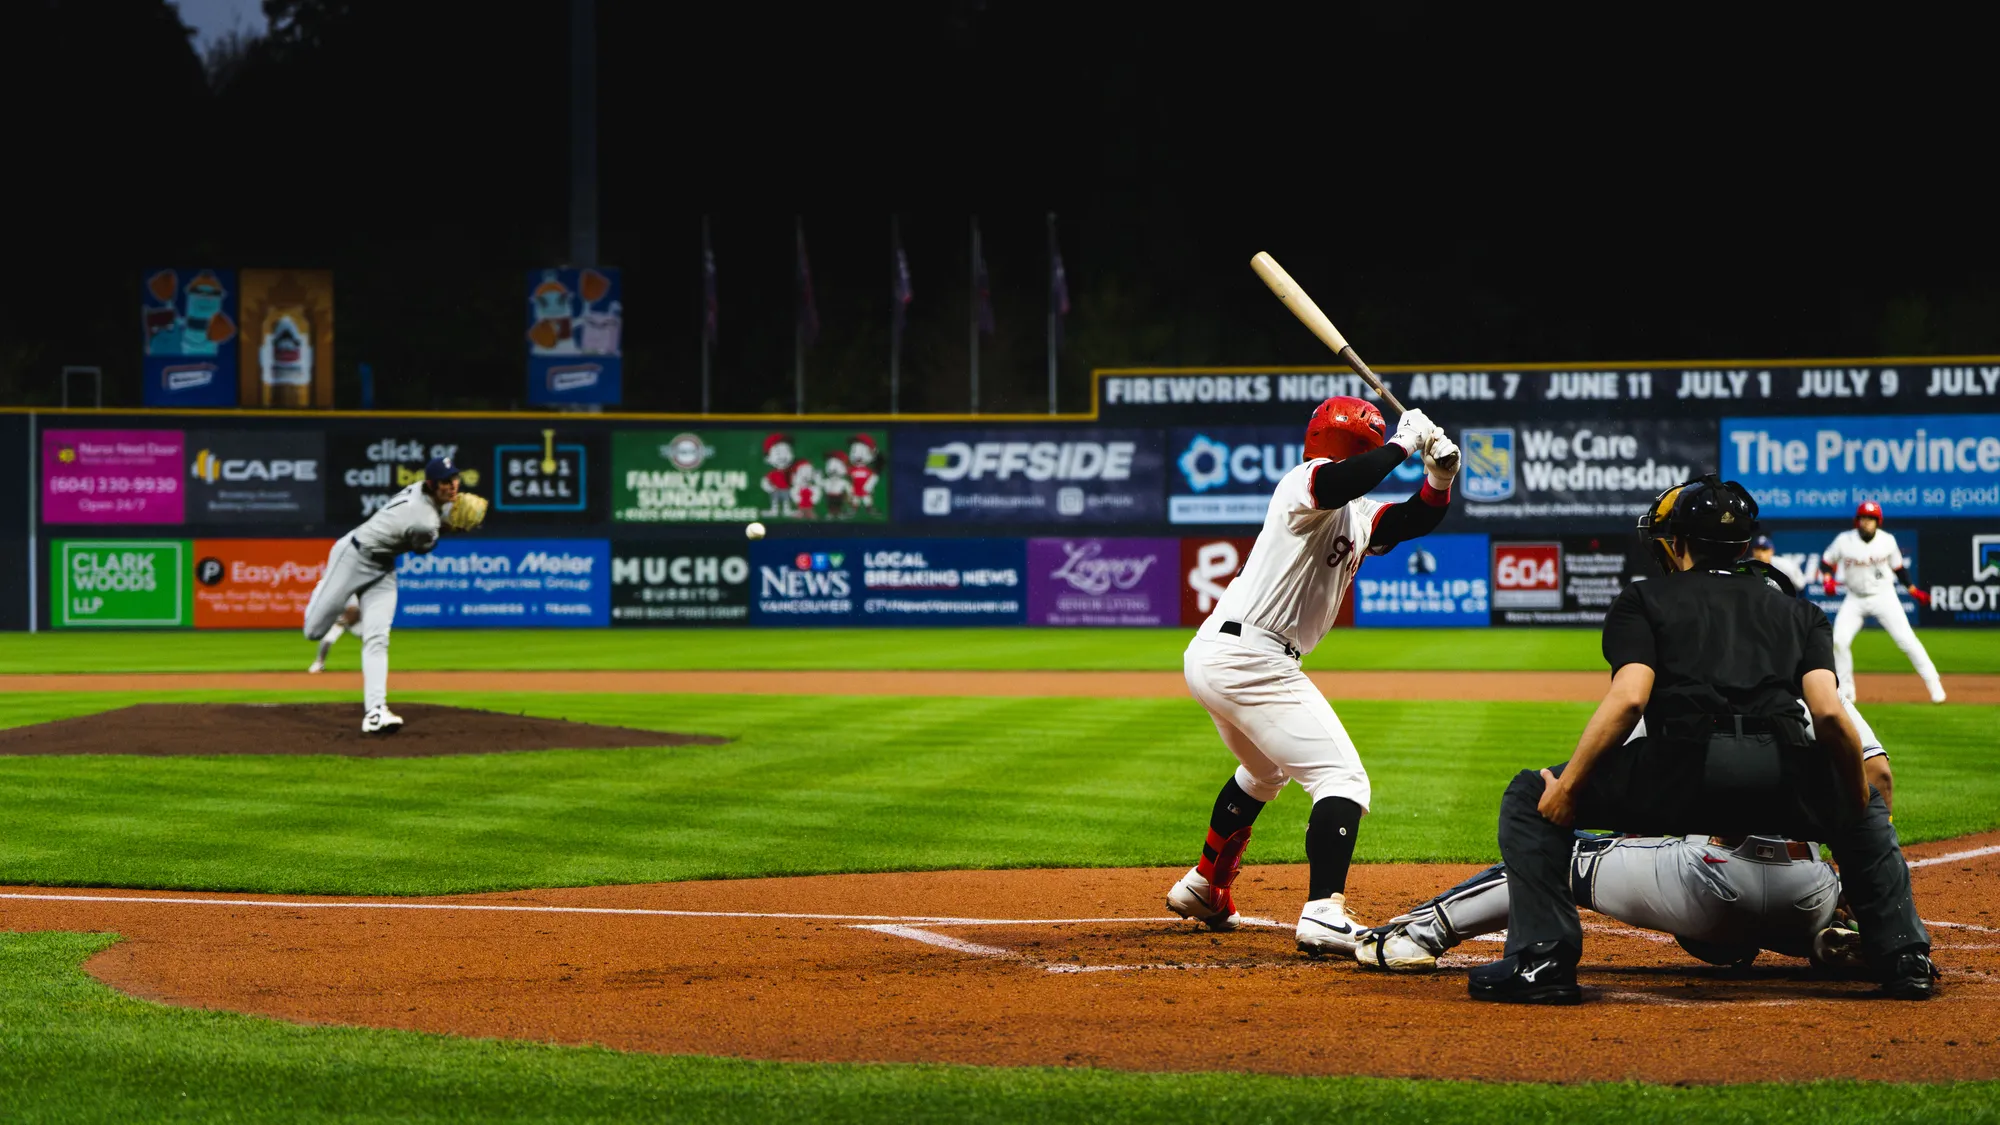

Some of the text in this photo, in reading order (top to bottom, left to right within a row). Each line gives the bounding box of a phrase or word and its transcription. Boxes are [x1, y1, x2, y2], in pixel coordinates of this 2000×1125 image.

[1107, 375, 1271, 403] FIREWORKS
[1409, 372, 1494, 400] APRIL
[1503, 372, 1520, 399] 7
[1545, 371, 1619, 399] JUNE
[1627, 371, 1651, 398] 11
[1677, 370, 1748, 398] JULY
[1757, 371, 1771, 397] 1
[1798, 368, 1870, 397] JULY
[1880, 369, 1899, 396] 9
[1927, 366, 2000, 396] JULY
[367, 439, 458, 462] click or
[1522, 430, 1638, 460] We Care
[1730, 428, 2000, 474] The Province
[222, 460, 317, 481] CAPE
[508, 459, 571, 477] BC 1
[924, 442, 1136, 481] OFFSIDE
[1230, 443, 1305, 483] CU
[50, 476, 177, 494] (604) 330-9930
[345, 465, 480, 487] call bere
[626, 470, 748, 490] FAMILY FUN
[1467, 477, 1509, 493] RBC
[1522, 459, 1691, 491] Wednesday
[508, 480, 572, 497] CALL
[1749, 483, 1999, 510] orts never looked so good
[78, 498, 147, 512] Open 24/7
[361, 494, 392, 517] yo
[637, 490, 737, 509] SUNDAYS
[72, 553, 155, 572] CLARK
[397, 551, 595, 575] Johnston Meier
[795, 552, 846, 570] CTV
[864, 551, 928, 568] LOCAL
[1049, 540, 1157, 595] Legacy
[612, 557, 749, 585] MUCHO
[864, 569, 1018, 586] BREAKING NEWS
[1496, 554, 1556, 587] 604
[73, 572, 156, 591] WOODS
[397, 576, 592, 592] Insurance Agencies Group
[1357, 578, 1488, 598] PHILLIPS
[641, 588, 720, 602] BURRITO
[1930, 585, 2000, 611] REOT
[73, 598, 103, 613] LLP
[403, 603, 592, 615] HOME BUSINESS TRAVEL
[759, 600, 852, 614] VANCOUVER
[1360, 598, 1456, 613] BREWING
